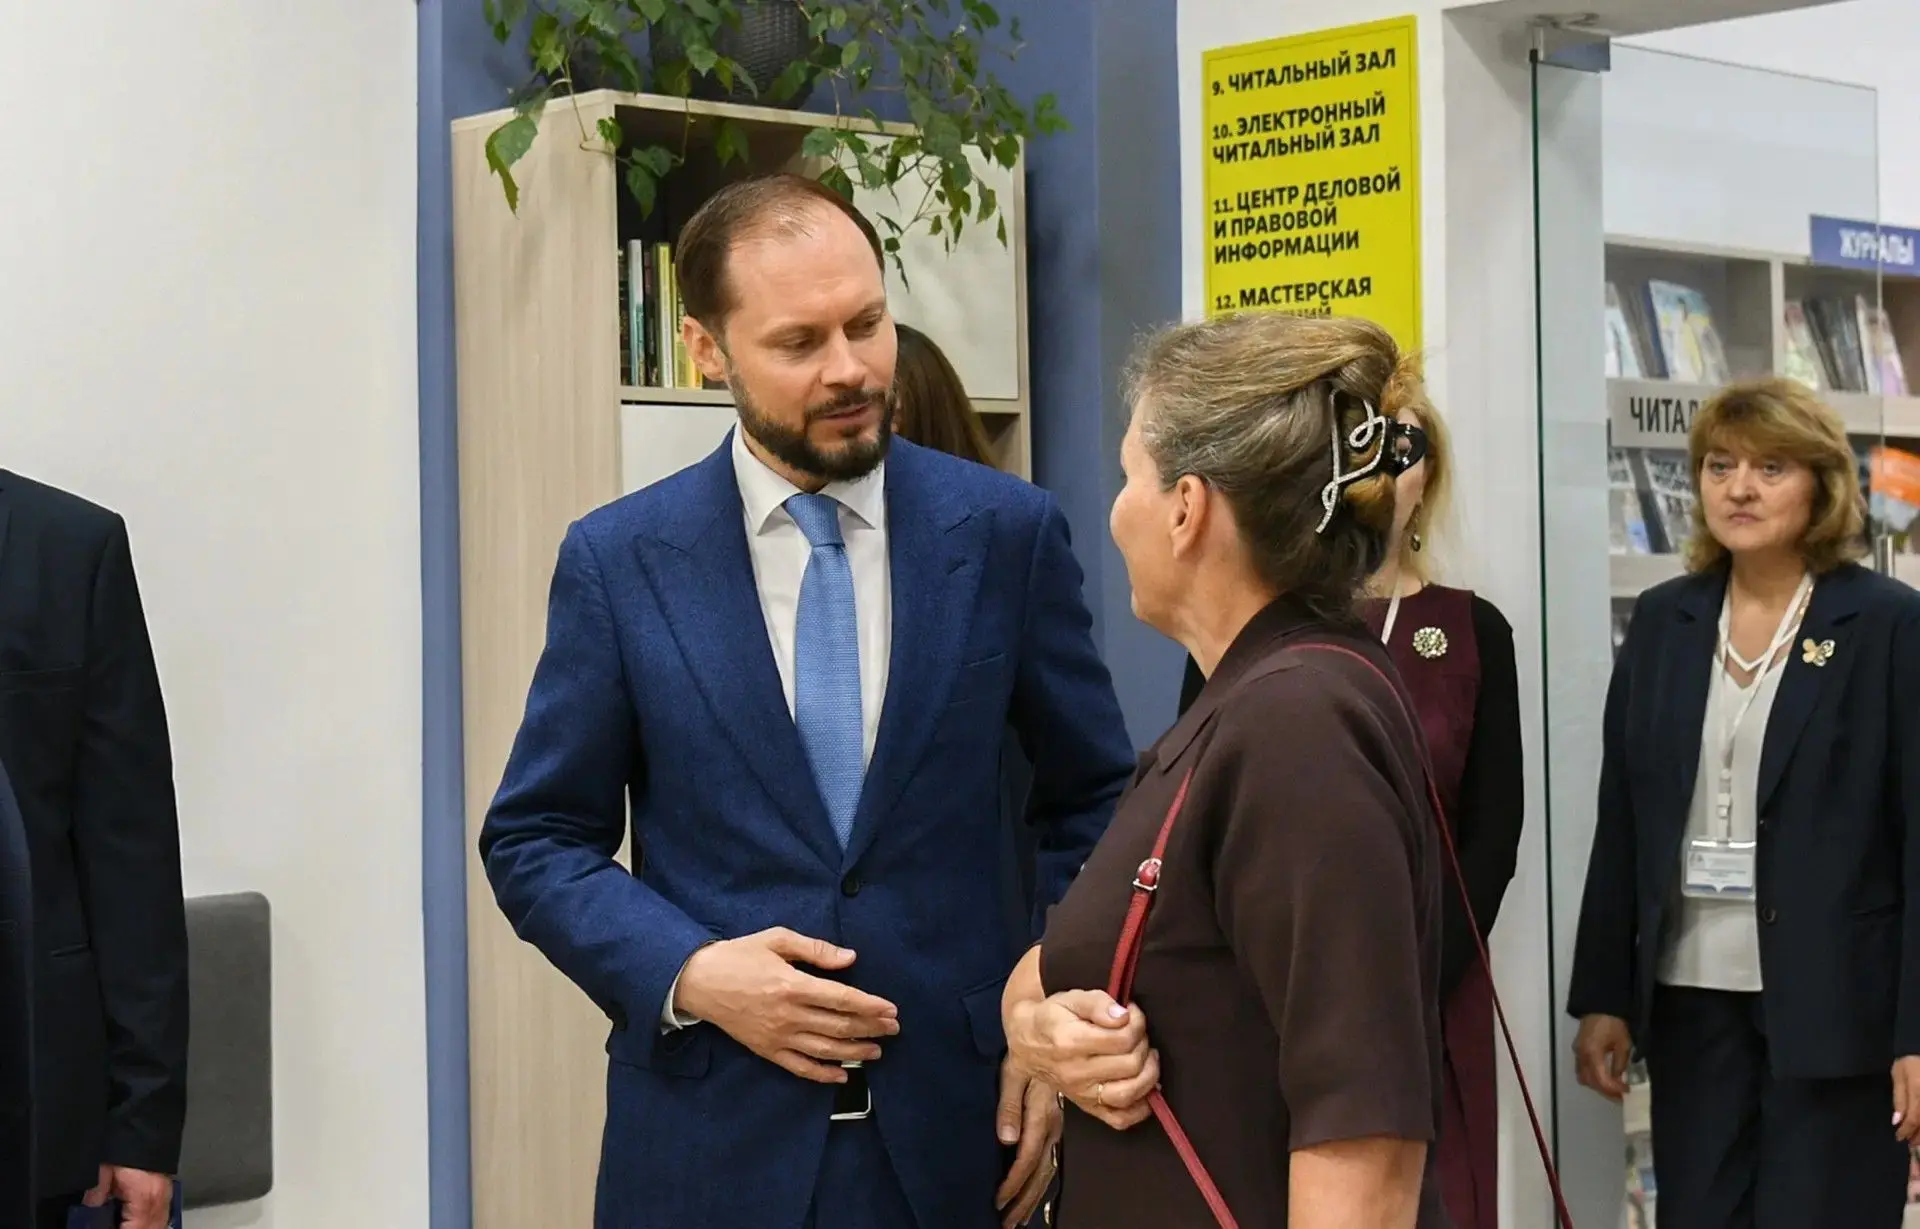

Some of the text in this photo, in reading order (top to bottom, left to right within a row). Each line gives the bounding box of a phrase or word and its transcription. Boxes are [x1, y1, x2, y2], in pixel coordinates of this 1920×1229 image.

[1212, 48, 1396, 96] 9. ЧИТАЛЬНЫЙ ЗАЛ
[1213, 91, 1386, 140] 10. ЭЛЕКТРОННЫЙ
[1213, 123, 1379, 164] ЧИТАЛЬНЫЙ ЗАЛ
[1213, 166, 1400, 214] 11. ЦЕНТР ДЕЛОВОЙ
[1214, 201, 1337, 239] И ПРАВОВОЙ
[1214, 230, 1359, 265] ИНФОРМАЦИИ
[1216, 276, 1372, 310] 12. МАСТЕРСКАЯ
